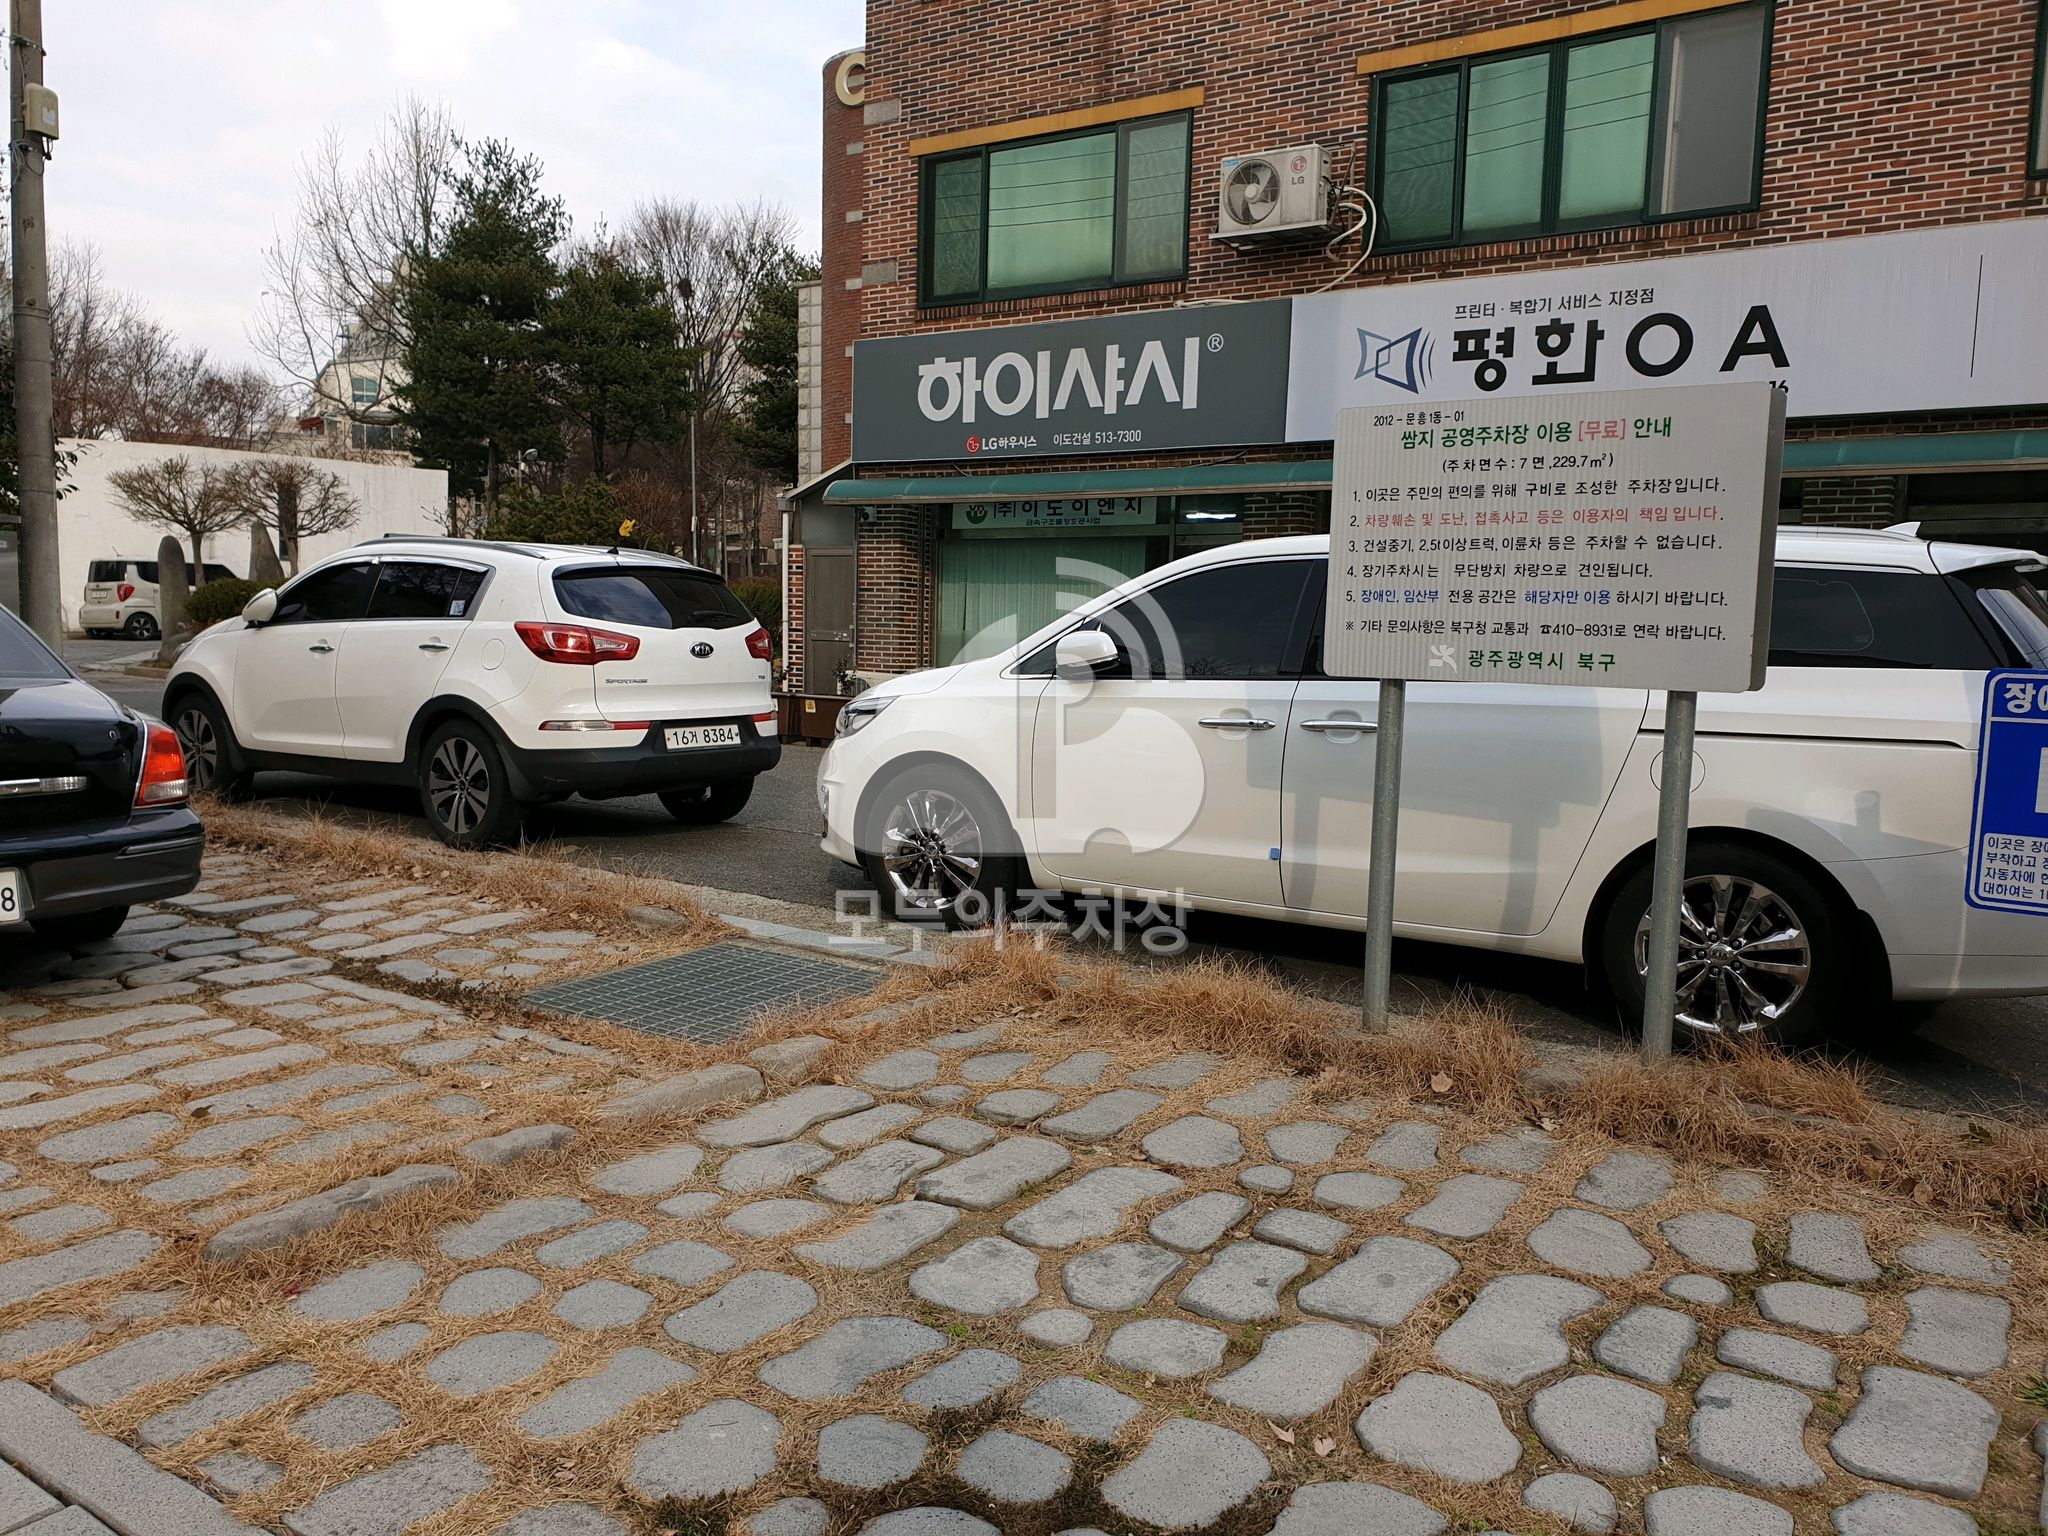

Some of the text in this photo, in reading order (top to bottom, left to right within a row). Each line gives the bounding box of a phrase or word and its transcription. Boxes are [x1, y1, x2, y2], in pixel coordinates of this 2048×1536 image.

[1292, 175, 1305, 185] LG
[1454, 303, 1495, 320] 프린터
[1509, 298, 1551, 314] 복합기
[1558, 293, 1602, 311] 서비스
[1609, 288, 1654, 306] 지정점
[917, 336, 1199, 424] 하이샤시
[1054, 432, 1091, 446] 이도건설
[1095, 430, 1142, 444] 513-7300
[1401, 429, 1434, 449] 쌈지
[1441, 424, 1529, 448] 공영주차장
[1537, 422, 1573, 443] 이용
[1634, 416, 1672, 438] 안내
[1366, 488, 1400, 501] 이곳은
[1406, 486, 1442, 500] 주민의
[1448, 484, 1485, 499] 편의를
[1491, 484, 1517, 497] 위해
[1525, 482, 1567, 497] 구비로
[1575, 481, 1618, 495] 조성한
[1365, 513, 1416, 527] 차량훼손
[1422, 513, 1433, 526] 및
[1440, 512, 1467, 526] 도난,
[1475, 510, 1528, 525] 접촉사고
[1537, 509, 1564, 525] 등은
[1573, 508, 1629, 524] 이용자의
[1364, 539, 1414, 552] 건설중기,
[1549, 536, 1576, 550] 등은
[1585, 536, 1628, 550] 주차할
[1634, 536, 1648, 549] 수
[1657, 534, 1722, 550] 없습니다.
[1362, 564, 1439, 578] 장기주차시는
[1454, 563, 1506, 577] 무단방치
[1514, 563, 1567, 577] 차량으로
[1578, 563, 1653, 578] 견인됩니다.
[1361, 589, 1399, 603] 장애인,
[1404, 589, 1439, 604] 임산부
[1448, 590, 1473, 604] 전용
[1478, 590, 1517, 604] 공간은
[1525, 590, 1578, 605] 해당자만
[1584, 590, 1610, 605] 이용
[1617, 590, 1659, 605] 하시기
[1665, 591, 1728, 606] 바랍니다.
[1360, 620, 1383, 632] 기타
[1387, 620, 1445, 634] 문의사항은
[1451, 621, 1487, 634] 북구청
[1491, 622, 1528, 635] 교통과
[1633, 624, 1659, 639] 연락
[1666, 625, 1726, 641] 바랍니다.
[1468, 650, 1616, 672] 광주광역시 북구
[704, 728, 733, 743] 8384
[1988, 837, 2024, 851] 이곳은
[1987, 852, 2036, 867] 부착하고
[1985, 867, 2034, 883] 자동차에
[1984, 882, 2033, 898] 대하여는
